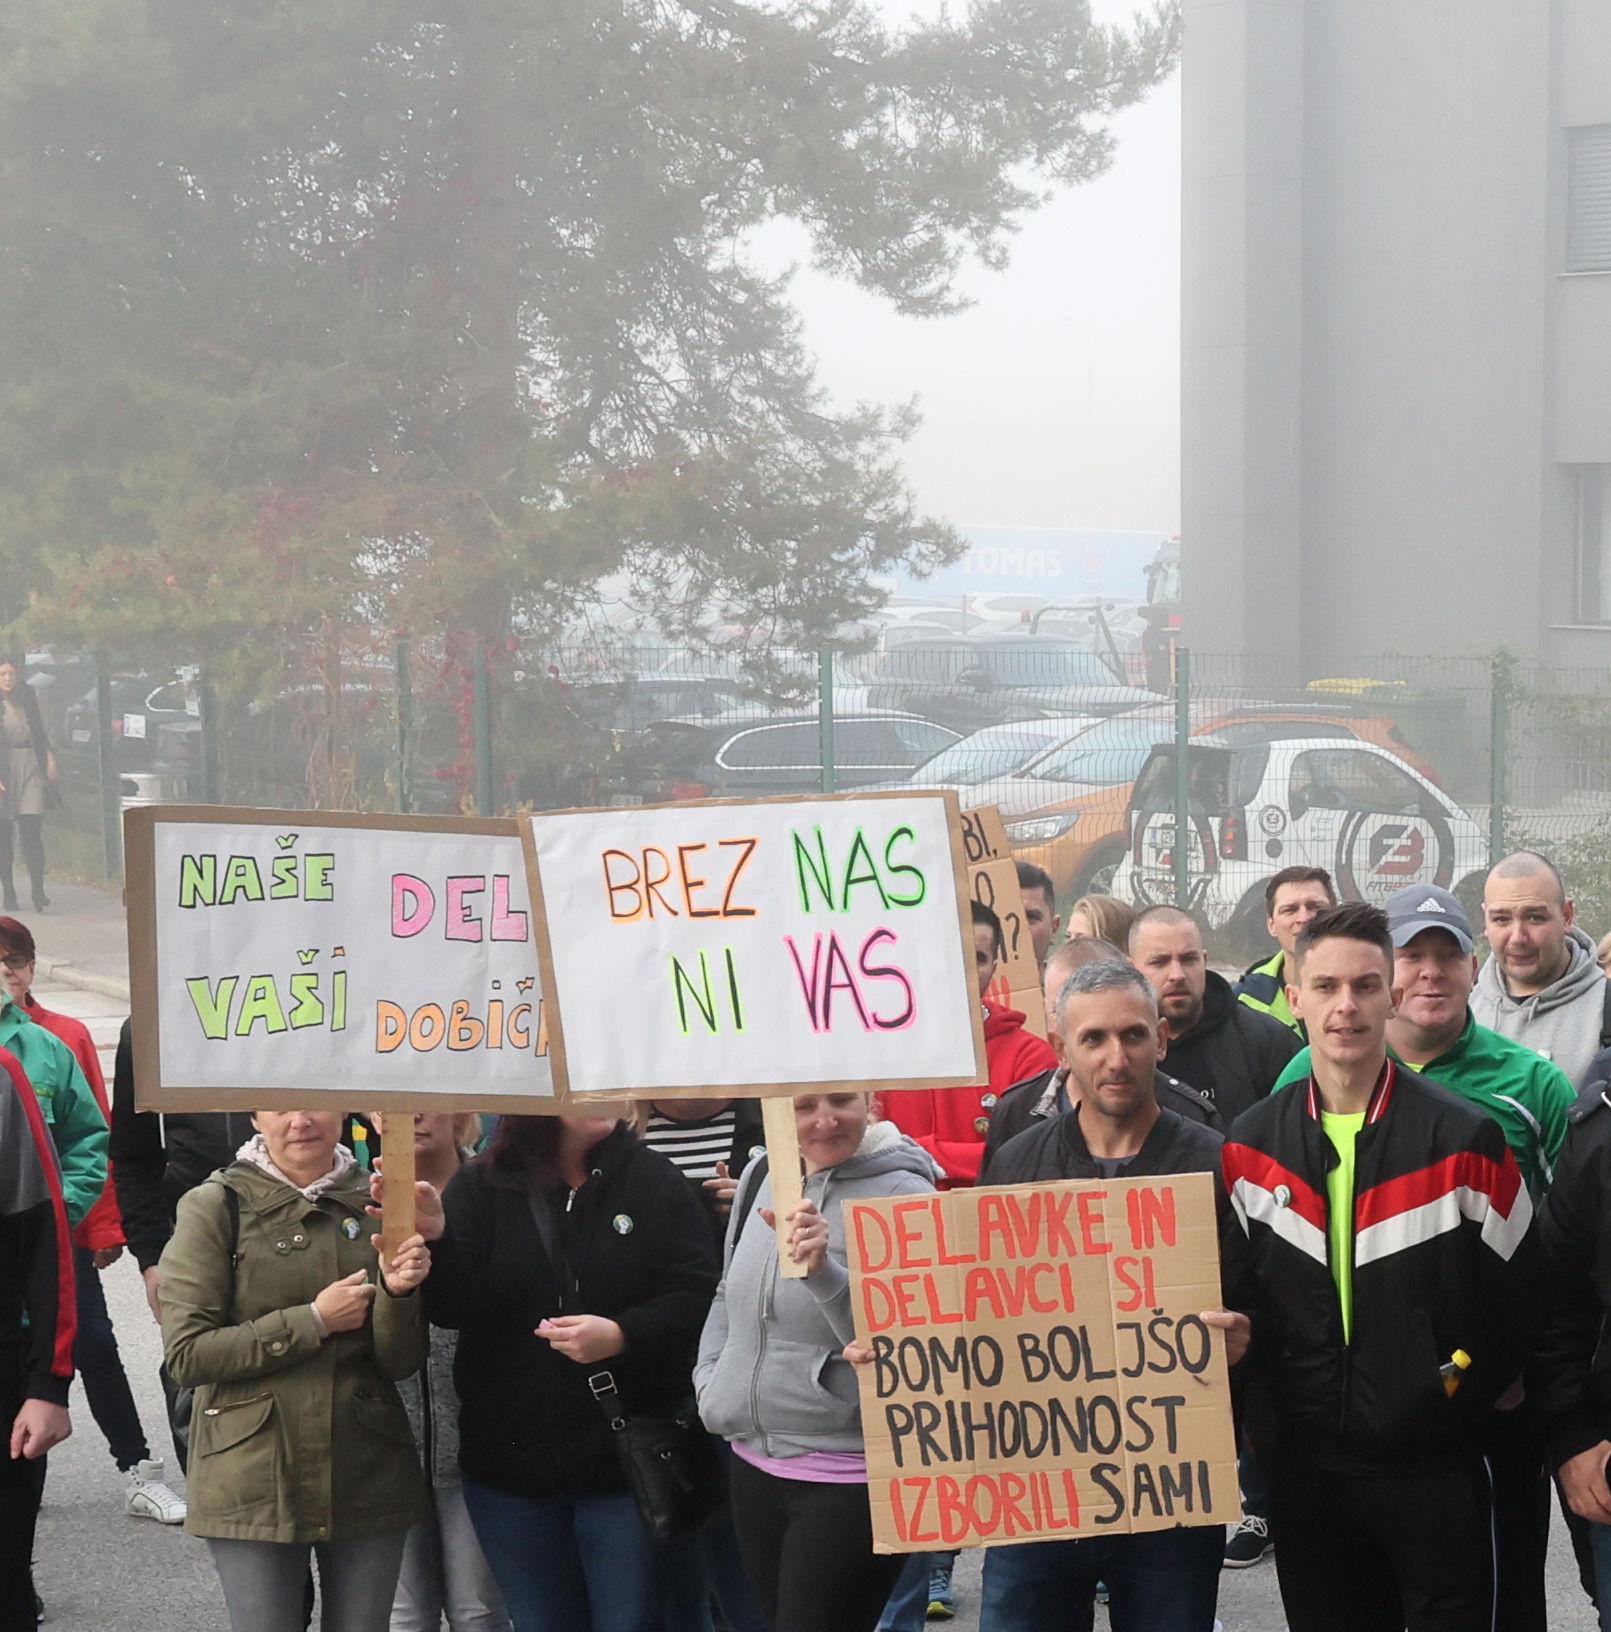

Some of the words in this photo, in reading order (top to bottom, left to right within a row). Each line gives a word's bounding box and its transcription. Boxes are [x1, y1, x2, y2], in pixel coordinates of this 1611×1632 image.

[178, 833, 336, 909] NAŠE
[602, 836, 760, 924] BREZ
[792, 824, 928, 914] NAS
[669, 946, 744, 1037] NI
[782, 926, 918, 1034] VAS
[853, 1190, 1113, 1274] DELAVKE
[1126, 1187, 1177, 1250] IN
[861, 1262, 1075, 1332] DELAVCI
[1114, 1256, 1157, 1312] SI
[872, 1333, 1003, 1398] BOMO
[1017, 1308, 1211, 1384] BOLJŠO
[885, 1394, 1186, 1467] PRIHODNOST
[889, 1468, 1080, 1543] IZBORILI
[1090, 1460, 1213, 1525] SAMI
